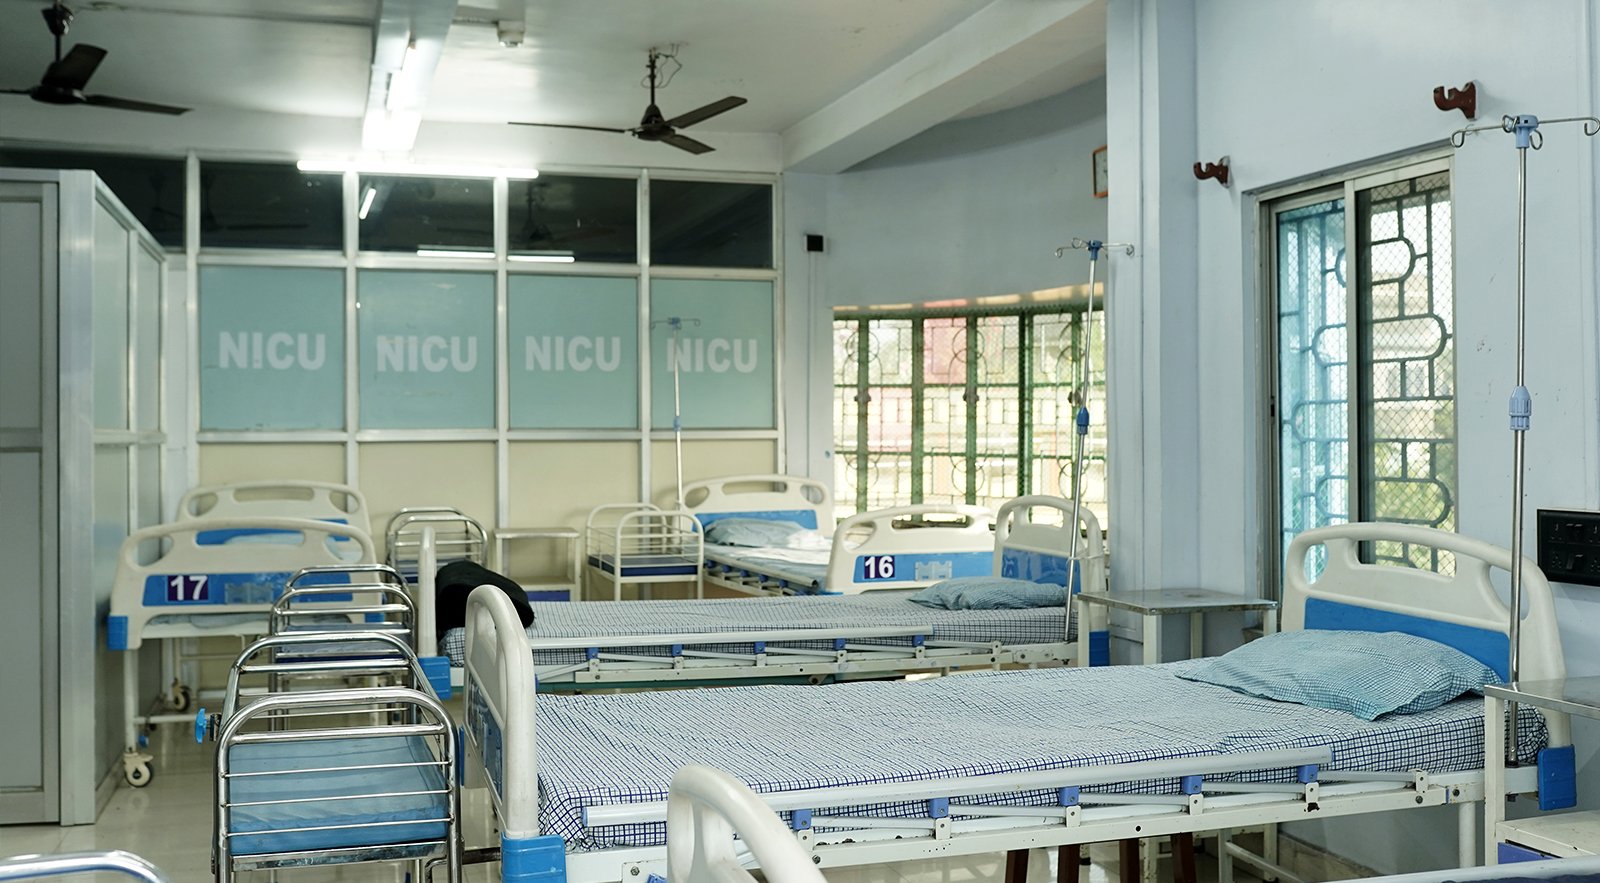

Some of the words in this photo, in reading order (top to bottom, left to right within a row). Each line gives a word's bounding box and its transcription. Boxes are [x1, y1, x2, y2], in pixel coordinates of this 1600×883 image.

[219, 331, 326, 370] NICU
[376, 335, 478, 372] NICU
[525, 336, 621, 372] NICU
[666, 338, 758, 373] NICU
[864, 556, 894, 579] 16
[170, 575, 208, 601] 17
